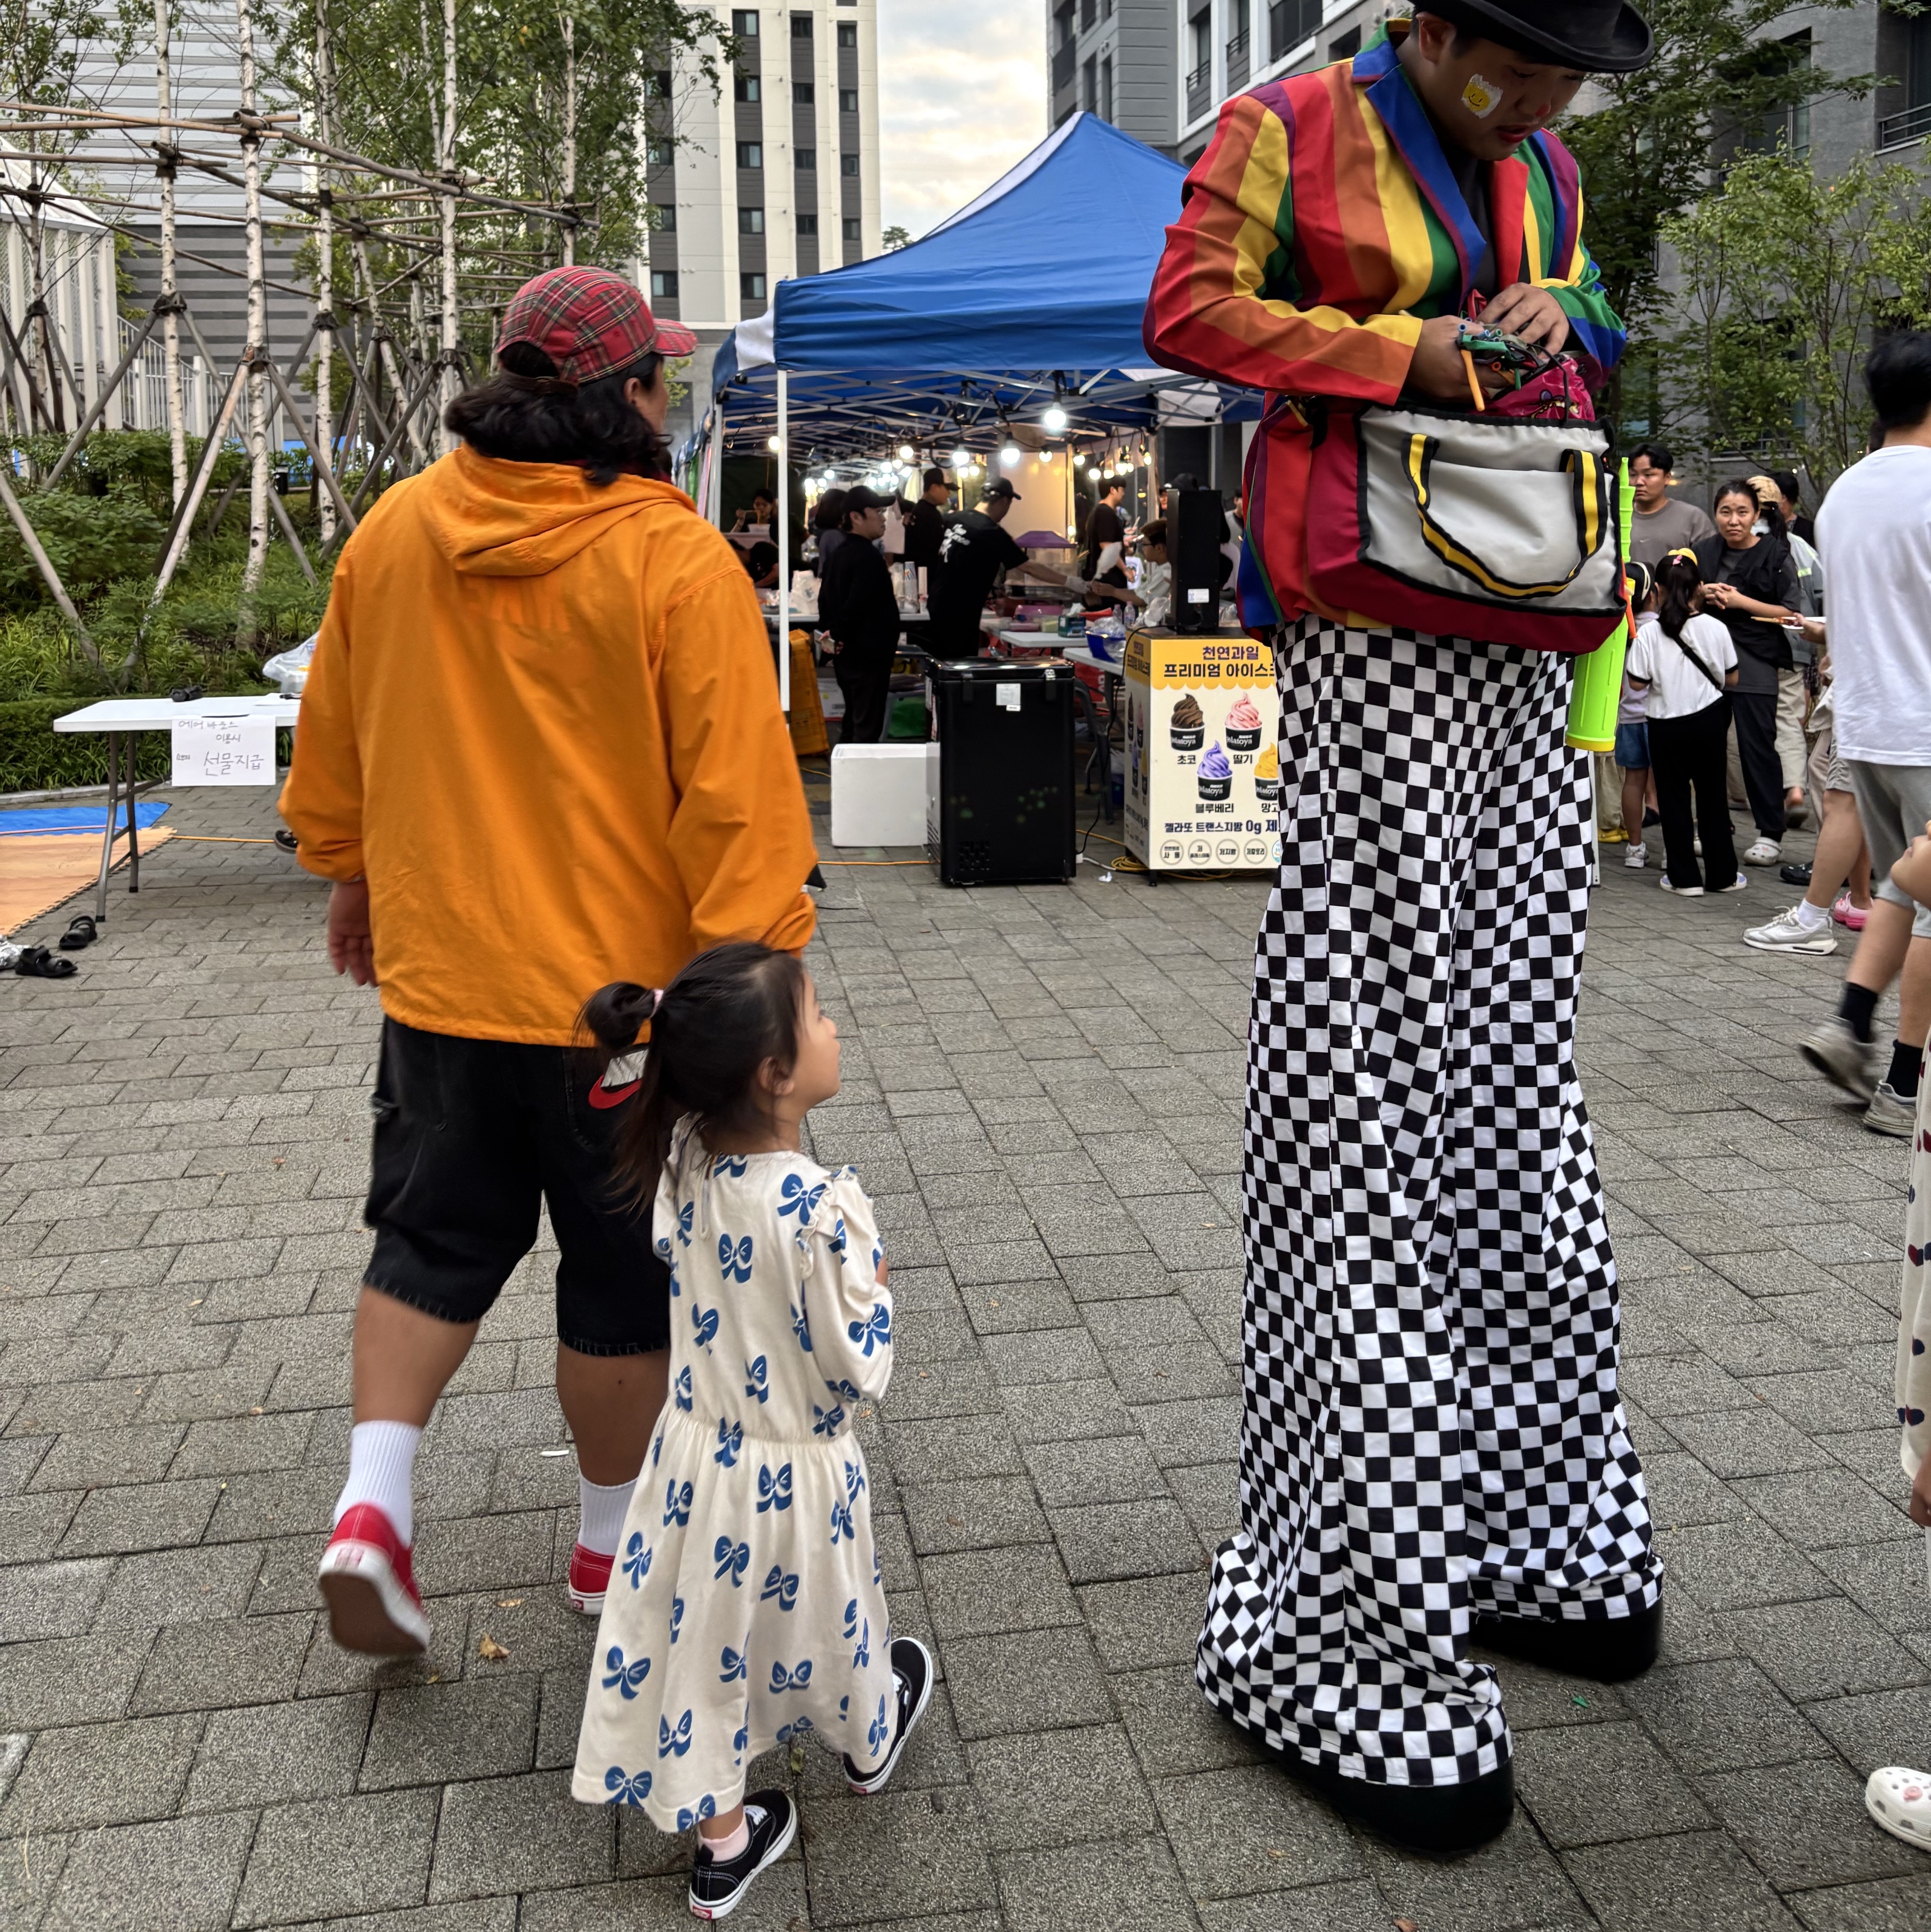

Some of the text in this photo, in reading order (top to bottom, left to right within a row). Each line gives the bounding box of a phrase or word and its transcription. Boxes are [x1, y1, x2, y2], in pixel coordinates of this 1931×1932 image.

[1202, 646, 1259, 660] 천연과일
[1164, 664, 1220, 677] 프리미엄
[1177, 755, 1196, 764] 초코
[1233, 754, 1252, 764] 딸기
[1196, 803, 1234, 813] 블루베리
[1165, 822, 1193, 832] 젤라또
[1246, 820, 1261, 835] 0g
